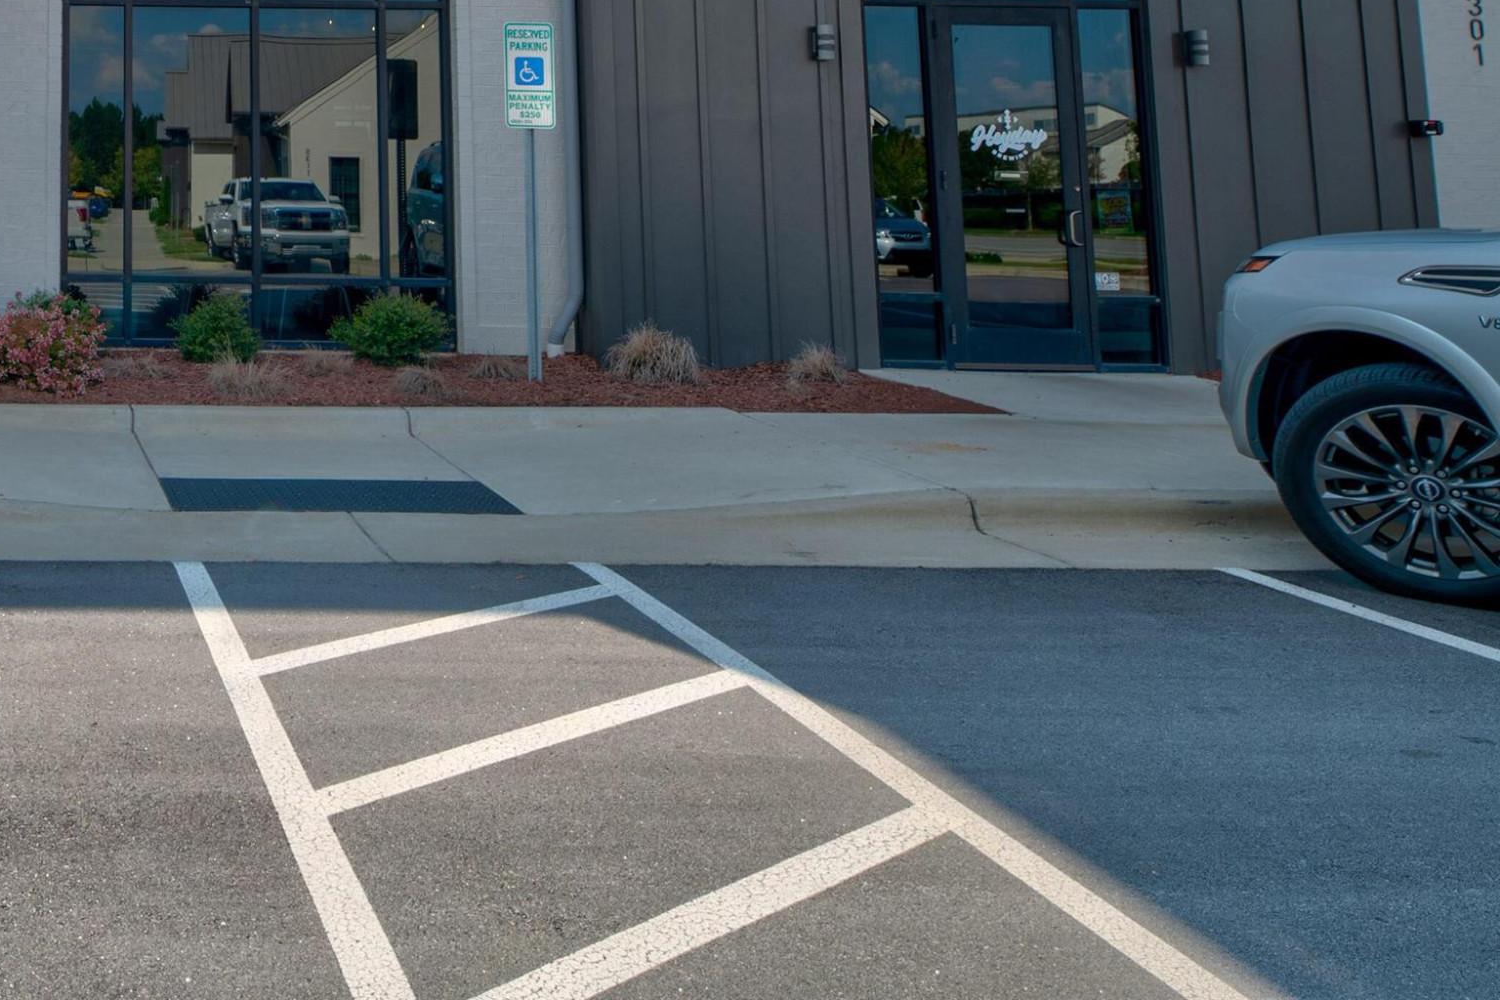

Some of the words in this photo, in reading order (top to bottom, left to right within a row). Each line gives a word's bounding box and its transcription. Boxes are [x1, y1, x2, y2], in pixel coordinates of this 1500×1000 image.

[507, 29, 550, 39] RESERVED
[509, 42, 548, 51] PARKING
[509, 102, 551, 110] PENALTY
[520, 111, 541, 119] $250
[970, 124, 1048, 153] Heyday
